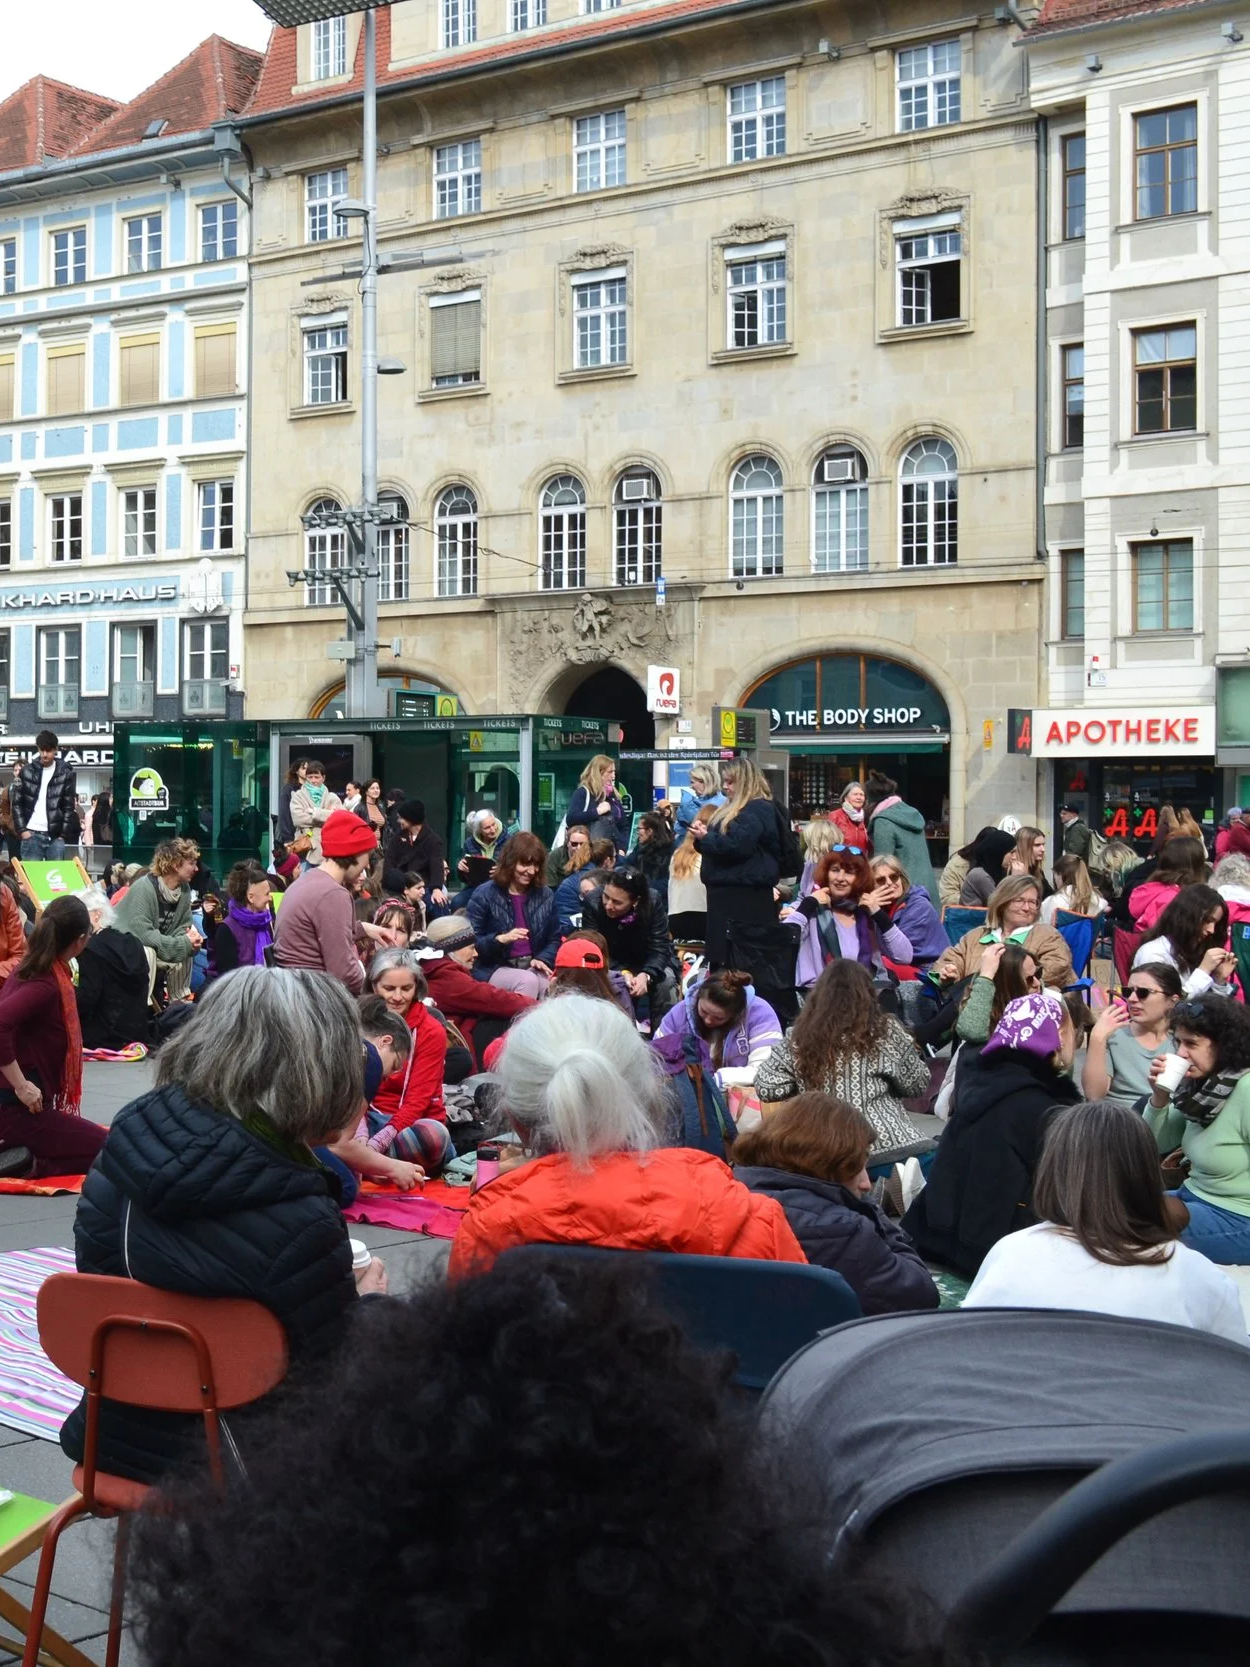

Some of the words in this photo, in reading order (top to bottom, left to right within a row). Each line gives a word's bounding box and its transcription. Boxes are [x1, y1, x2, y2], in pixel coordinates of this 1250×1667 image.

[656, 699, 677, 708] ruefa
[785, 710, 817, 726] THE
[824, 708, 870, 725] BODY
[873, 707, 921, 724] SHOP
[370, 722, 400, 730] TICKETS
[423, 720, 455, 729] TICKETS
[483, 719, 516, 728] TICKETS
[543, 718, 562, 728] TICKETS
[581, 720, 599, 730] TICKETS
[1046, 718, 1199, 744] APOTHEKE
